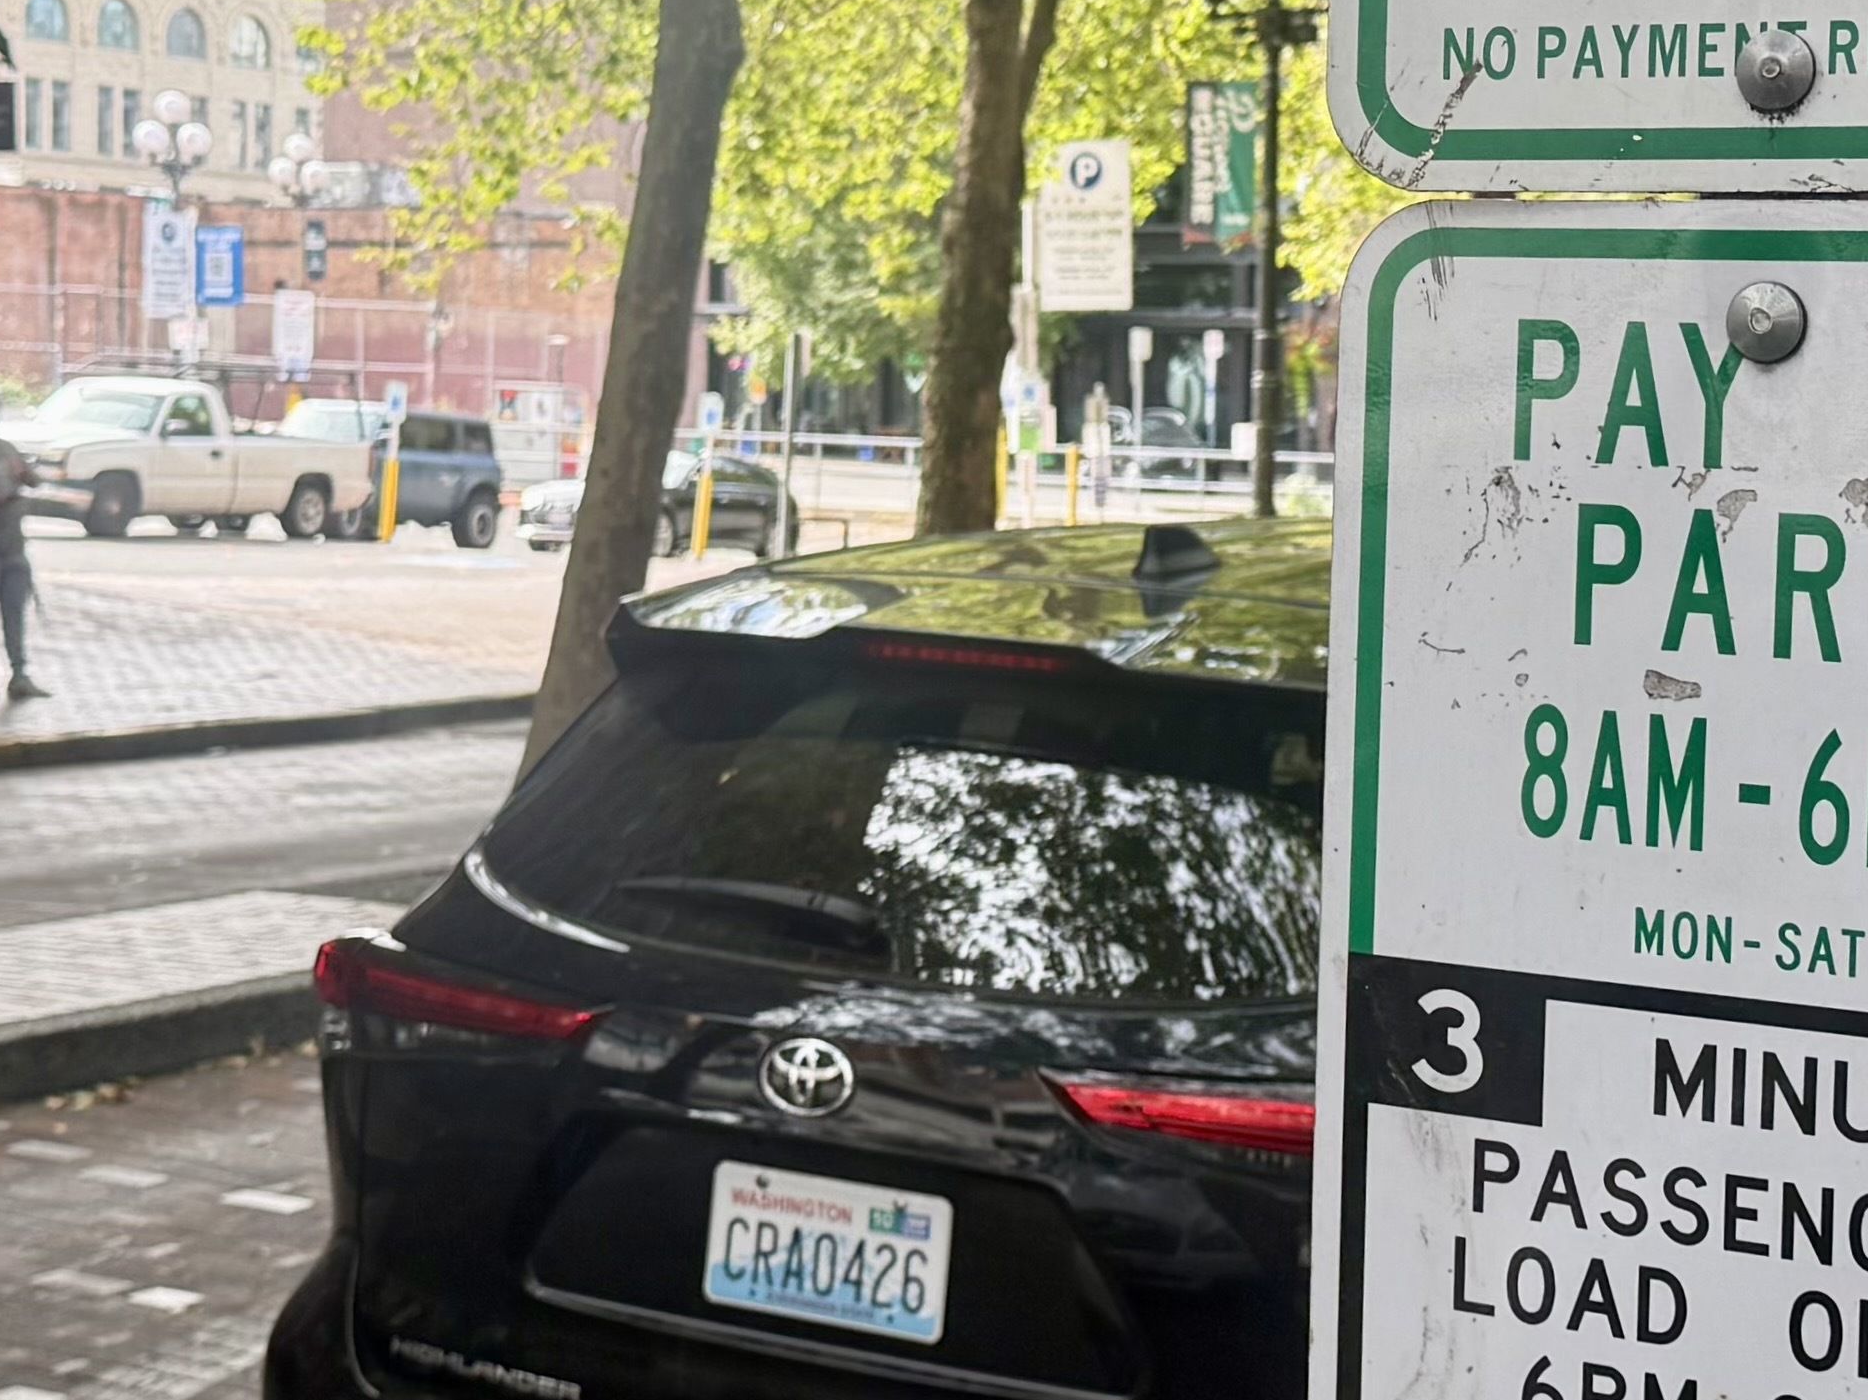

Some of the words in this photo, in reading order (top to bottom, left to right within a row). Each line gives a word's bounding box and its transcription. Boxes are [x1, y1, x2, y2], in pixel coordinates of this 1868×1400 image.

[1442, 25, 1517, 81] NO
[1512, 317, 1754, 471] PAY
[1632, 905, 1868, 980] MON-SAT
[1410, 987, 1485, 1094] 3
[731, 1188, 854, 1225] WASHINGTON
[723, 1216, 929, 1315] CRA0426
[1452, 1234, 1689, 1347] LOAD
